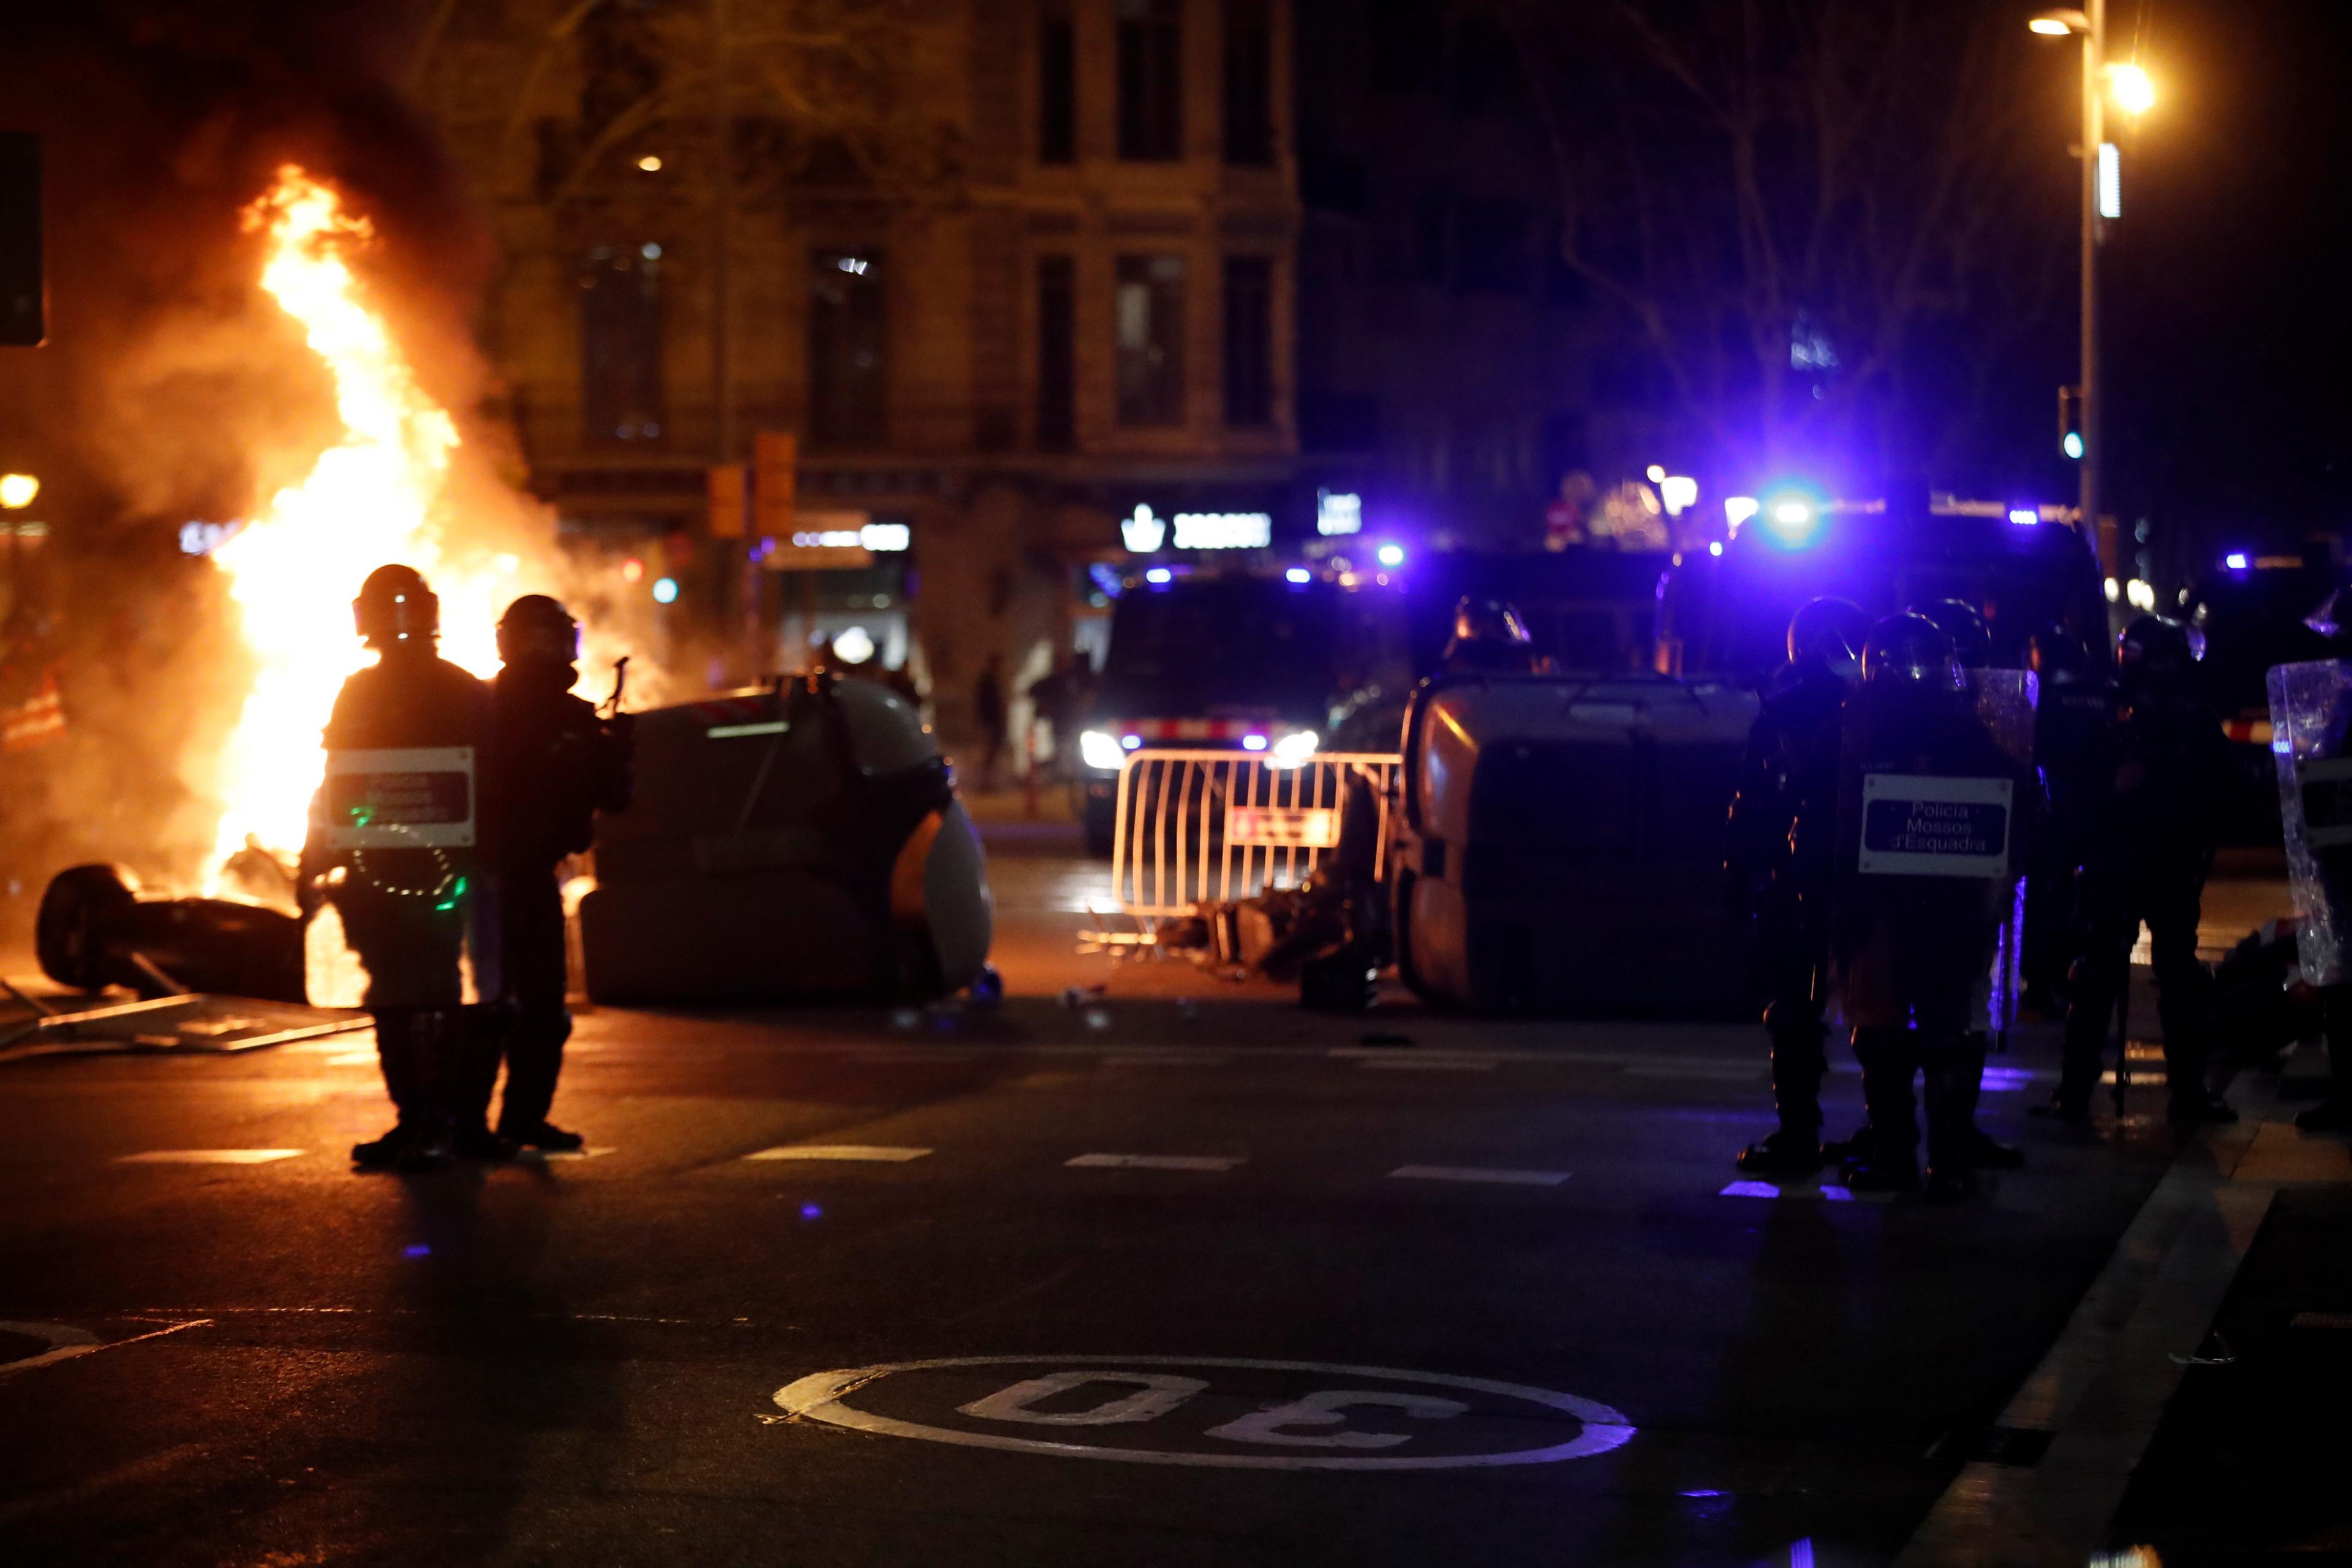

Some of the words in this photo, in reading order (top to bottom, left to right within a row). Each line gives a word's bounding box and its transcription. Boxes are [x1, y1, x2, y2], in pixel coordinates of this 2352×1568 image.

[1906, 818, 1972, 835] Mossos
[1889, 832, 1986, 854] d'Esquadra
[956, 1371, 1469, 1448] 30
